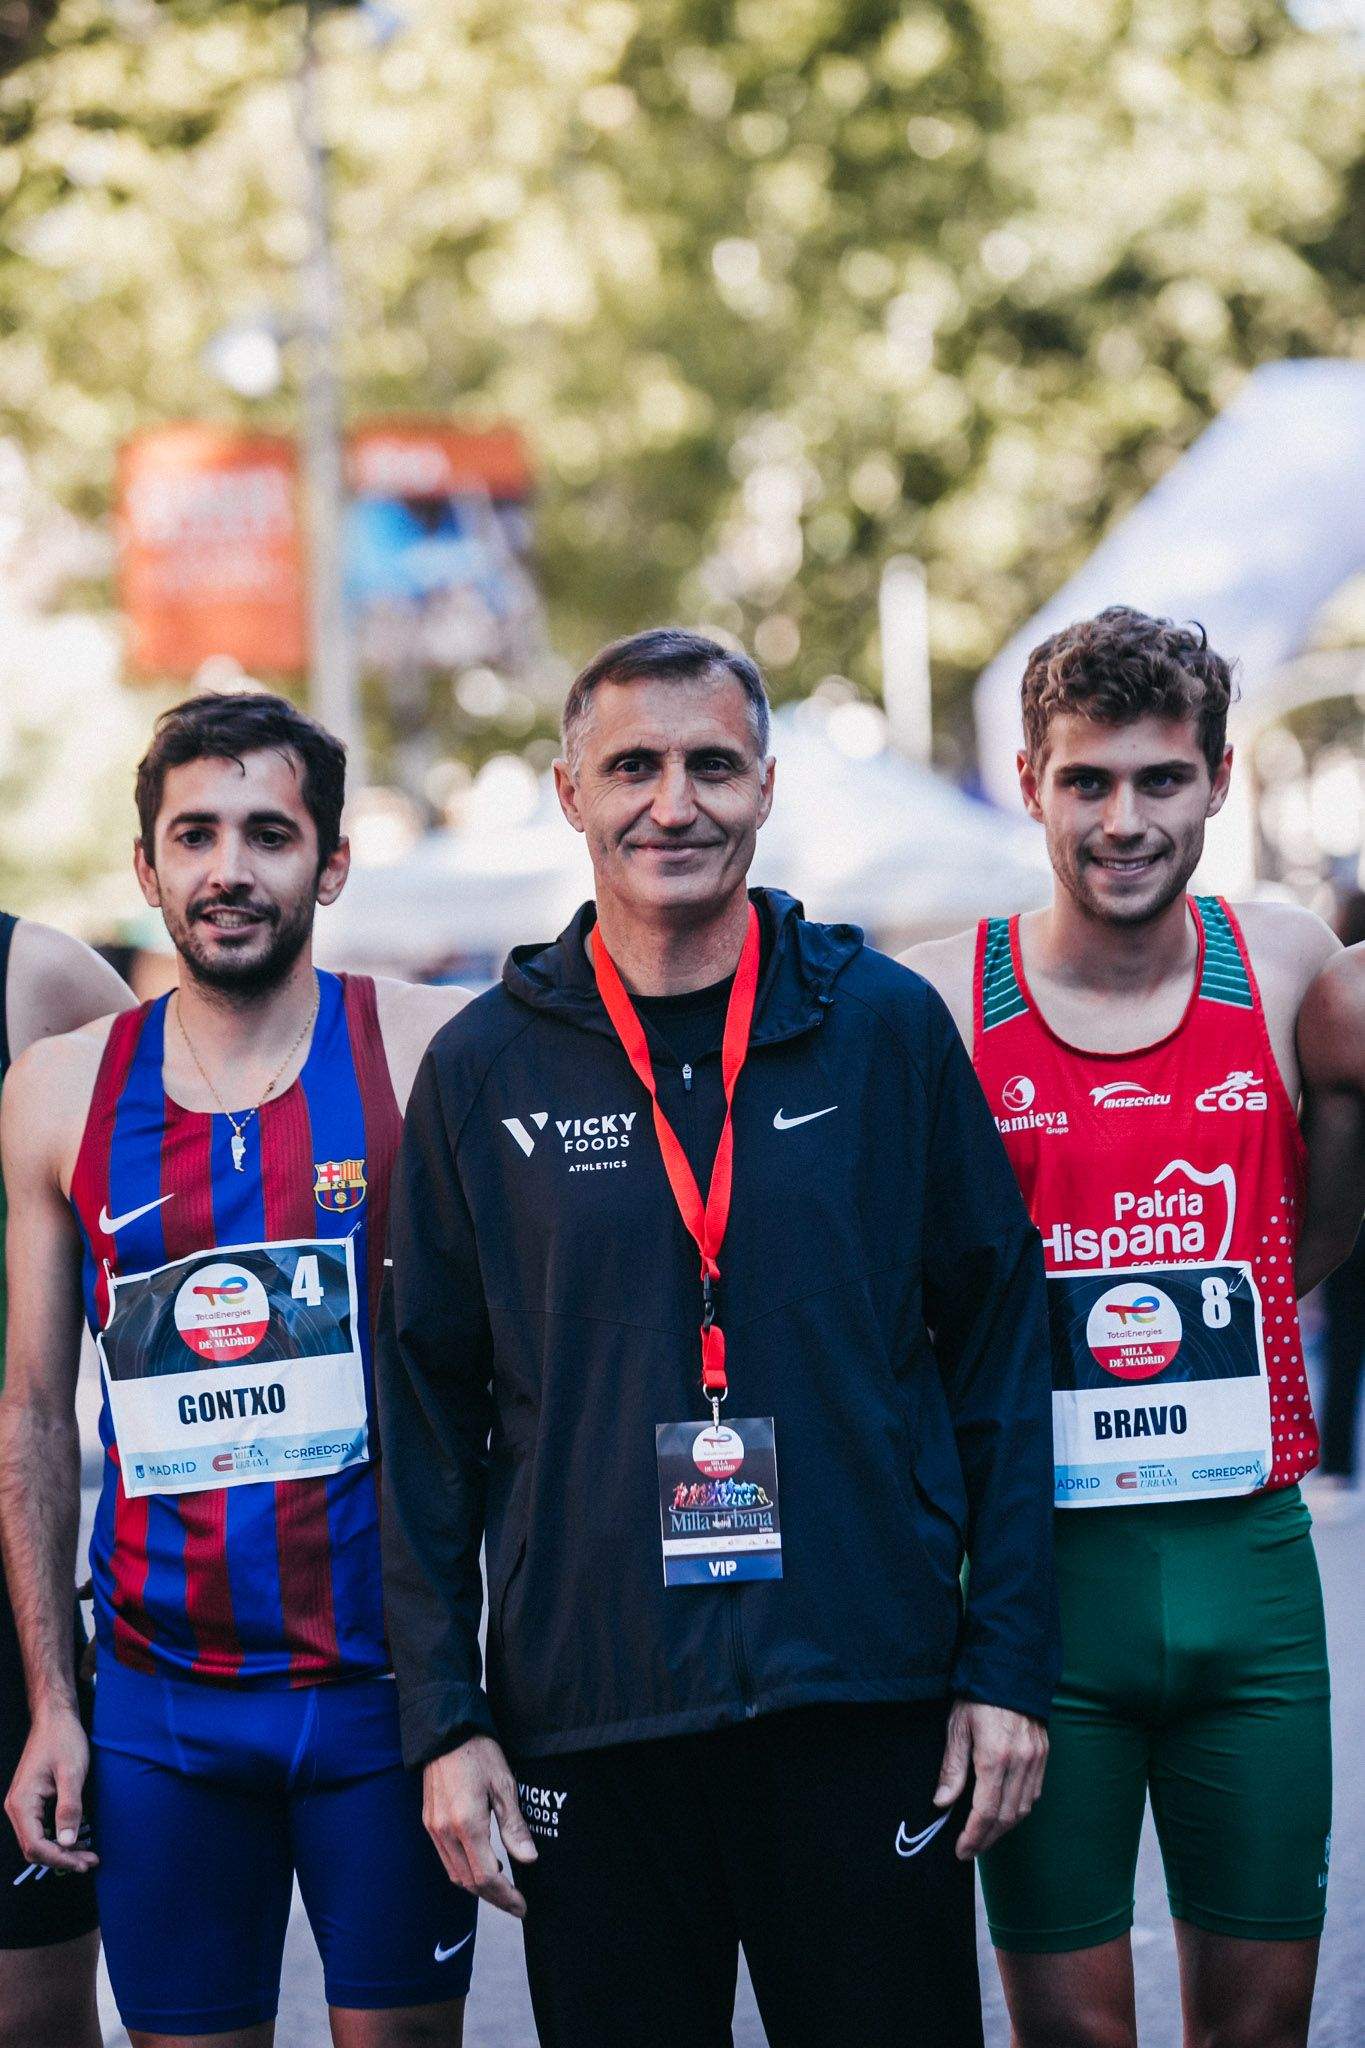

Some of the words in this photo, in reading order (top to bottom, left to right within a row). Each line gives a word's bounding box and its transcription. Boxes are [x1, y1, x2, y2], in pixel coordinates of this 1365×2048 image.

[555, 1112, 637, 1138] VICKY
[1046, 1126, 1069, 1135] Grupo
[564, 1134, 630, 1153] FOODS
[568, 1160, 628, 1172] ATHLETICS
[1114, 1188, 1203, 1221] Patria
[1042, 1221, 1205, 1268] Hispana
[291, 1255, 325, 1307] 4
[1201, 1276, 1232, 1329] 8
[195, 1309, 251, 1320] TotalEnergies
[209, 1327, 242, 1338] MILLA
[1107, 1329, 1162, 1339] TotalEnergies
[198, 1340, 213, 1350] DE
[214, 1335, 255, 1348] MADRID
[1120, 1345, 1153, 1357] MILLA
[1109, 1358, 1124, 1368] DE
[1125, 1355, 1165, 1367] MADRID
[178, 1383, 286, 1425] GONTXO
[1093, 1404, 1188, 1441] BRAVO
[149, 1461, 197, 1477] MADRID
[1139, 1469, 1173, 1478] MILLA
[1056, 1477, 1101, 1490] ADRID
[671, 1510, 710, 1532] Milla
[708, 1561, 738, 1577] VIP
[518, 1783, 567, 1809] VICKY
[522, 1803, 559, 1825] OODS
